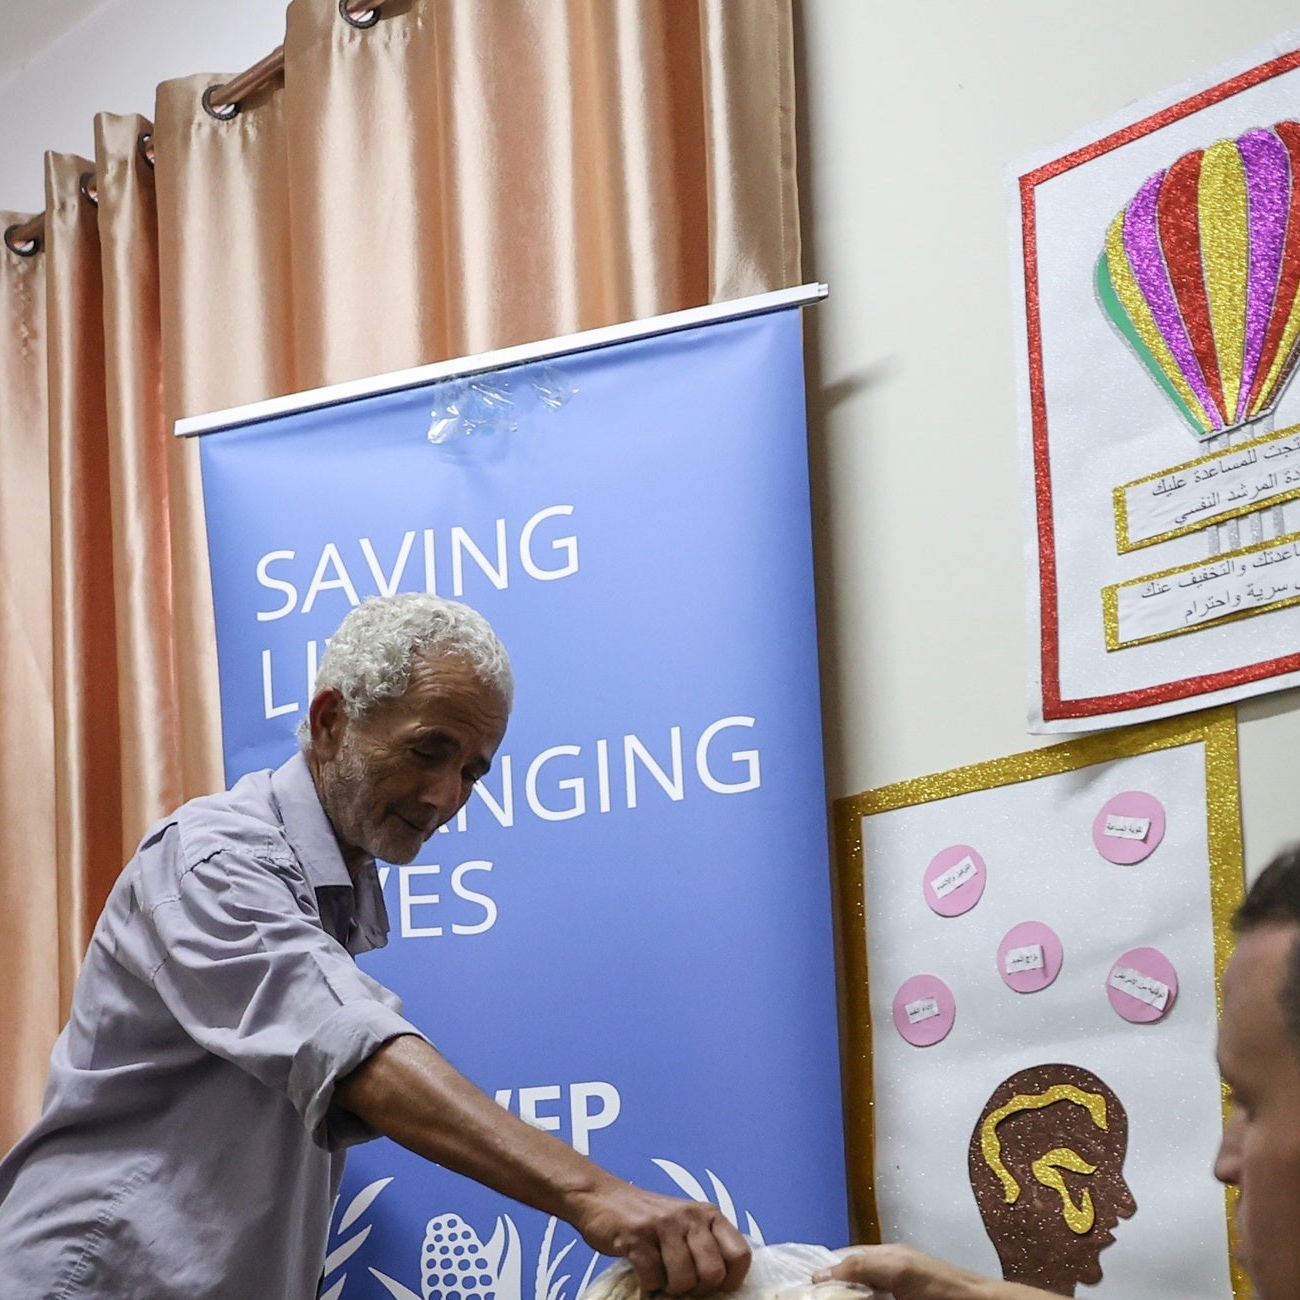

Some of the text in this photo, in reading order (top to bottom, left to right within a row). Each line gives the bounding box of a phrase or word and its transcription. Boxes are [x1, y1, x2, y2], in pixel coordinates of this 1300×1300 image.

[1194, 448, 1258, 484] للمساعدة
[1152, 475, 1187, 497] عليك
[1227, 472, 1278, 501] المرشد
[1174, 492, 1220, 524] النفسي
[255, 504, 580, 622] SAVING
[1178, 559, 1247, 588] والتخفيف
[1141, 582, 1172, 599] عنك
[1185, 590, 1242, 623] واحترام
[1247, 582, 1288, 601] سرية
[438, 715, 762, 835] NGING
[495, 1081, 621, 1157] FP
